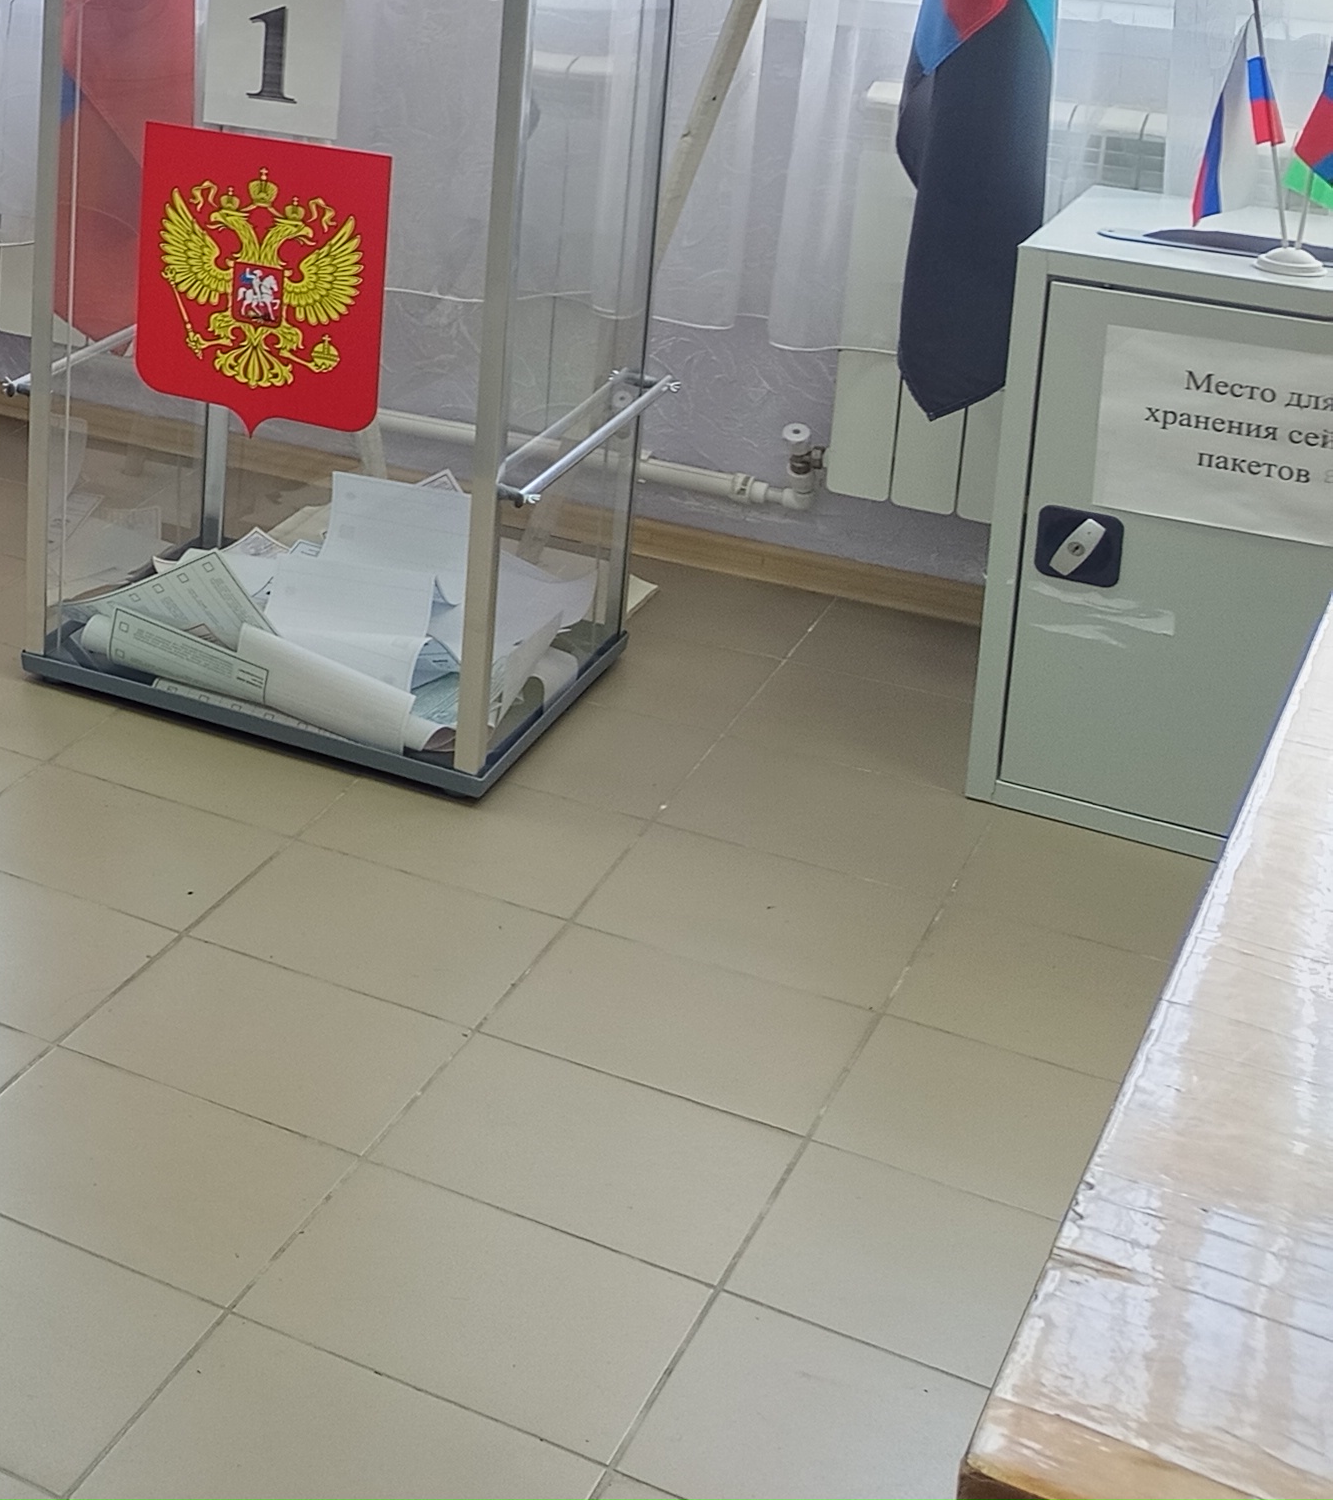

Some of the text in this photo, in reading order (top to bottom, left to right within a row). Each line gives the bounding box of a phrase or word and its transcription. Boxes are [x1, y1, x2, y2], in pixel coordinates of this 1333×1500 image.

[246, 6, 297, 104] 1
[1184, 370, 1276, 403] Место
[1144, 406, 1279, 441] хранения
[1197, 452, 1311, 483] пакетов
